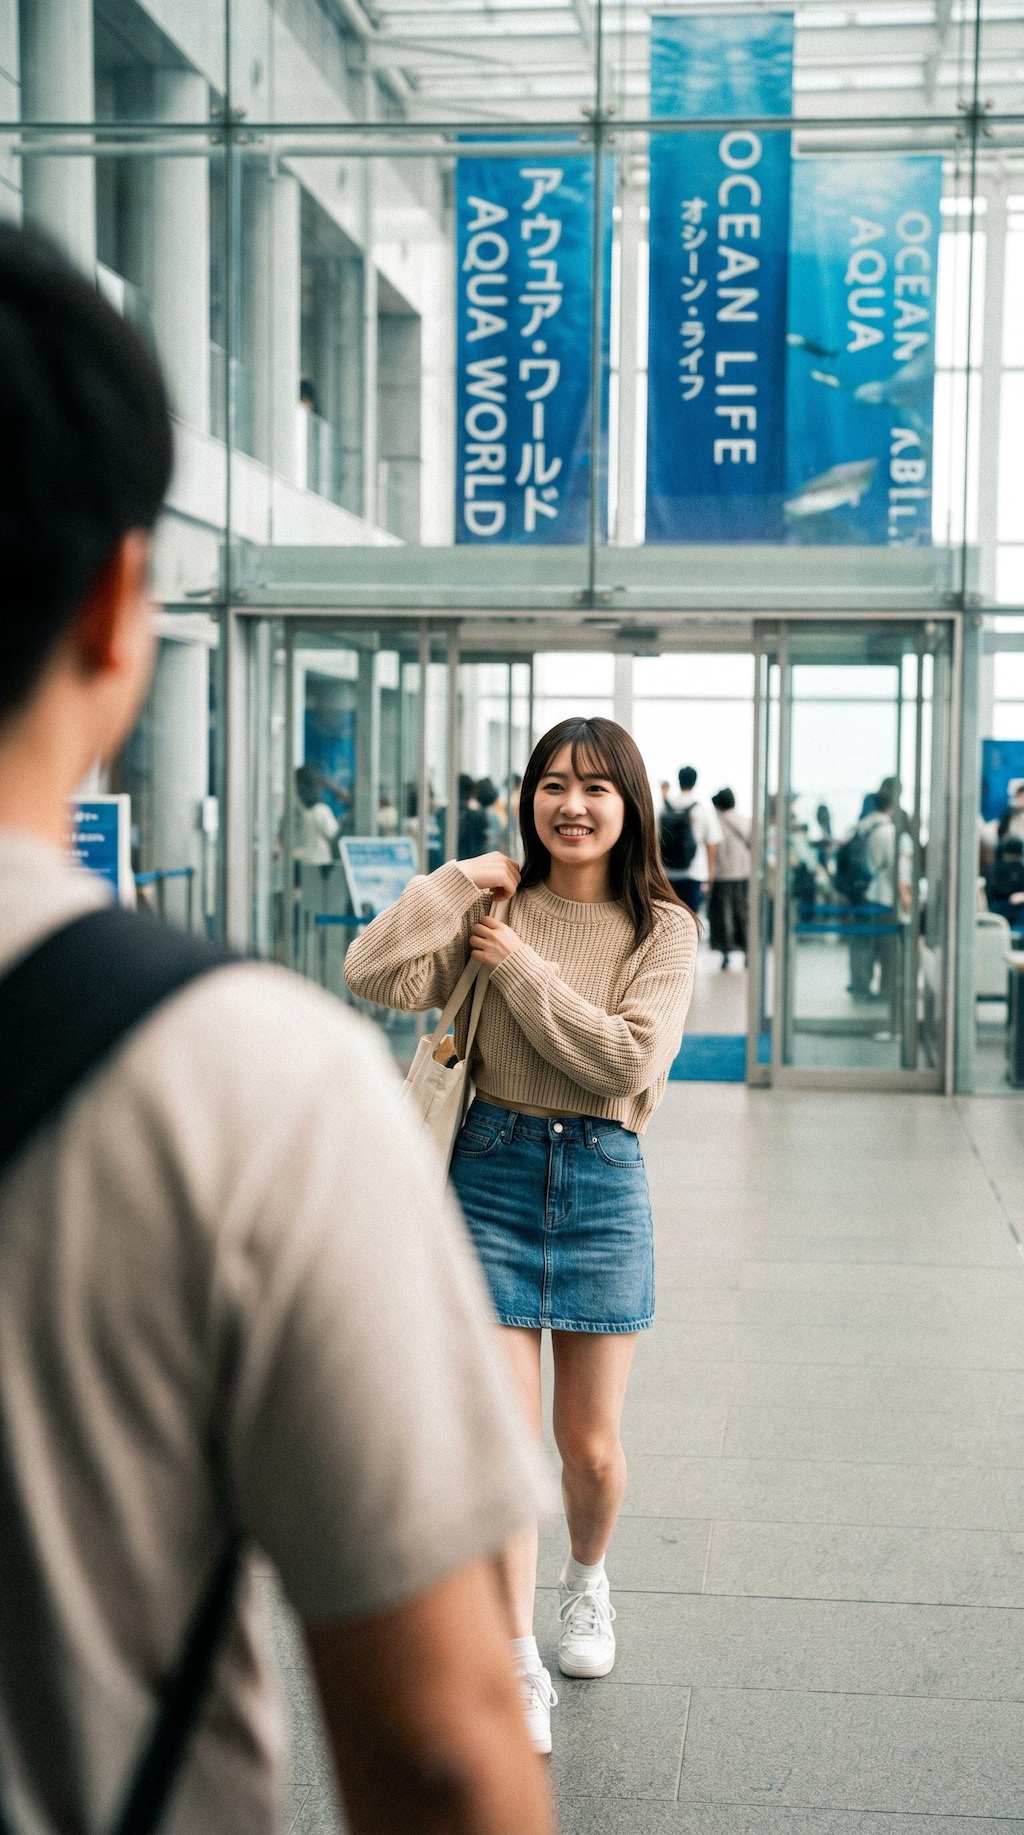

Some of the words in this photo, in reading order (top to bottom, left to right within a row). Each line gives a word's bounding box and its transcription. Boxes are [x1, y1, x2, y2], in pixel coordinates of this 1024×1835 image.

[463, 195, 509, 342] AQUA
[716, 129, 762, 322] OCEAN
[845, 216, 887, 353] AQUA
[893, 211, 932, 362] OCEAN
[464, 356, 507, 537] WORLD
[713, 351, 758, 465] LIFE
